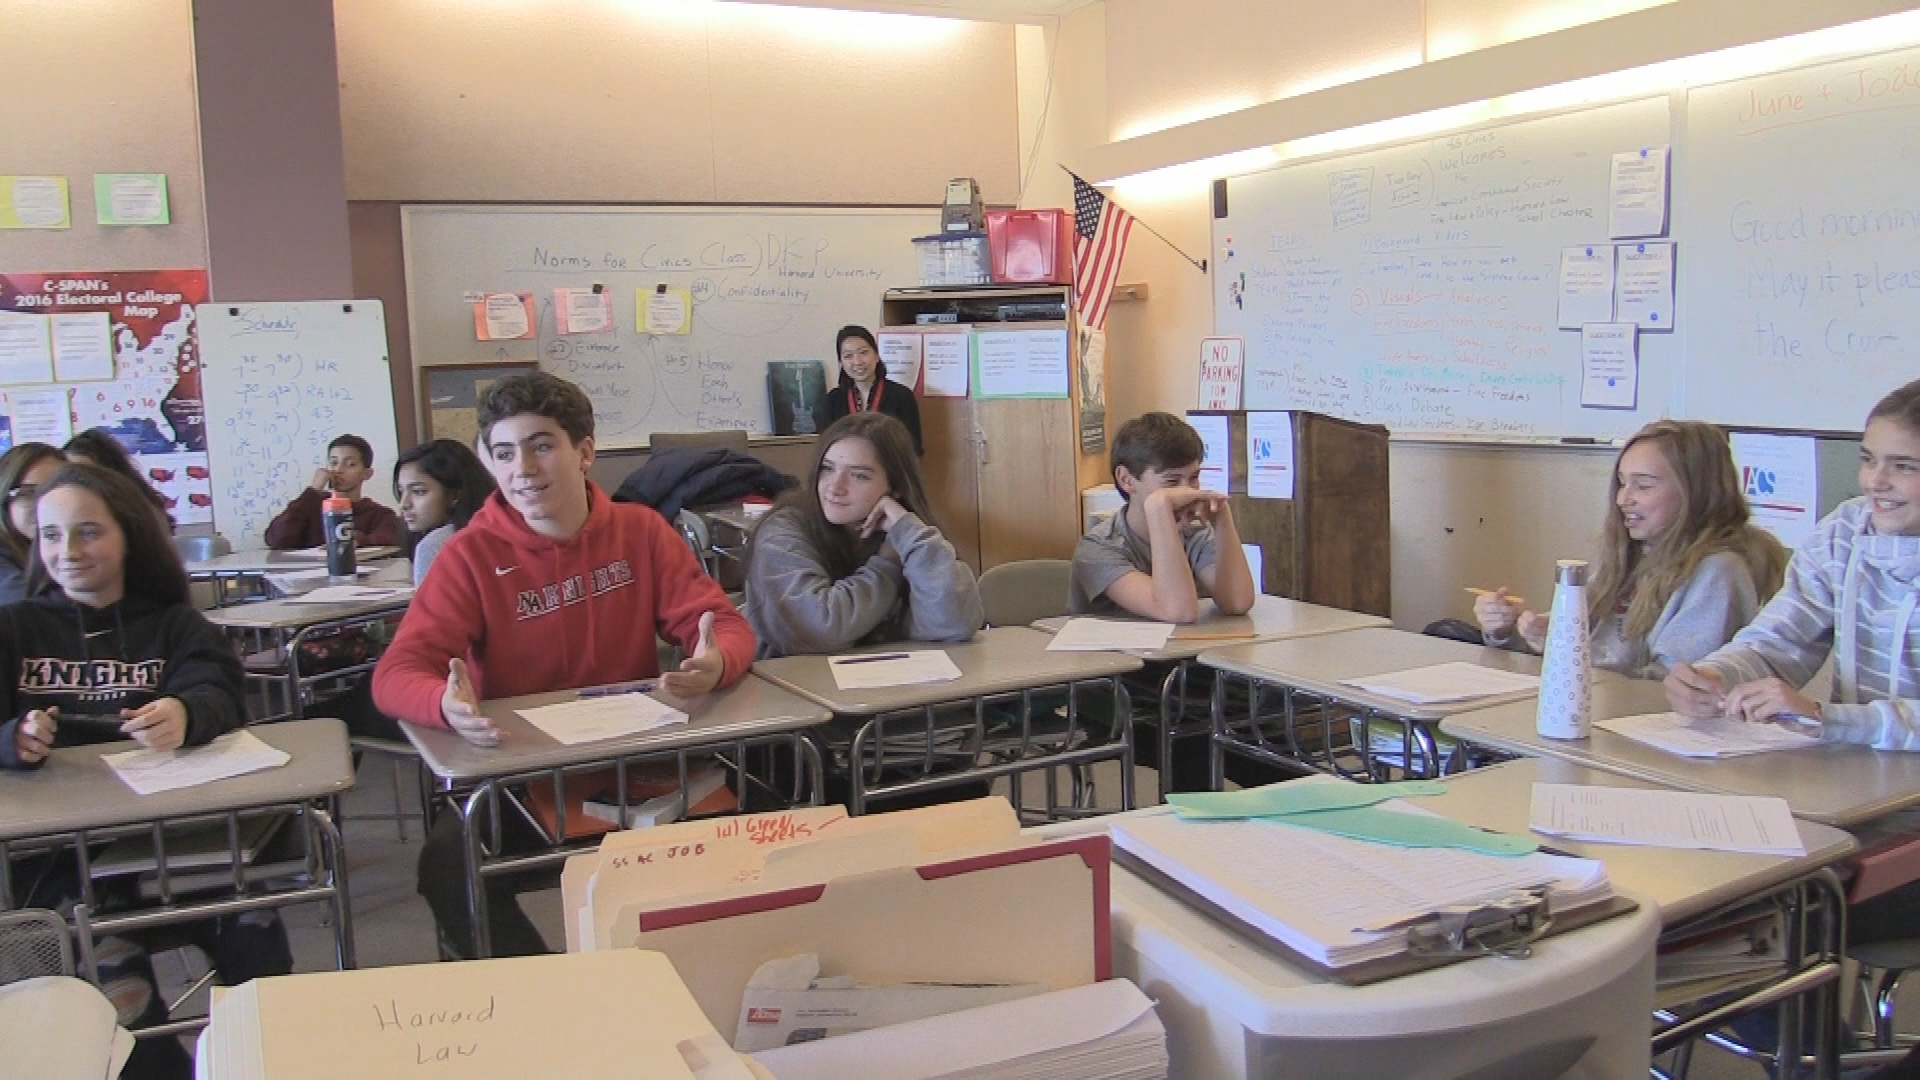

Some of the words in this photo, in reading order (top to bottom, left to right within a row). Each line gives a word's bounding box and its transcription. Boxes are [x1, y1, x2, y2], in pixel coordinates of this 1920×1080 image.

[1738, 88, 1804, 124] June
[1438, 145, 1508, 172] Welcomes
[1730, 202, 1807, 244] Good
[1820, 208, 1920, 238] mornin
[533, 246, 592, 269] Norms
[640, 243, 693, 269] Civics
[43, 279, 110, 293] C-SPAN's
[717, 277, 812, 303] Confidentiality
[1747, 258, 1807, 308] May
[1820, 260, 1841, 293] it
[15, 294, 53, 307] 2016
[56, 291, 123, 306] Electoral
[125, 289, 183, 305] College
[123, 305, 159, 319] Map
[1753, 312, 1803, 357] the
[1211, 344, 1229, 362] NO
[1201, 362, 1239, 382] PARKING
[96, 392, 105, 402] 6
[1209, 385, 1227, 397] TOW
[113, 403, 122, 413] 6
[126, 399, 136, 409] 9
[141, 397, 156, 408] 16
[1375, 397, 1402, 413] Class
[1411, 397, 1454, 416] Debate
[335, 520, 353, 541] G
[542, 559, 634, 608] KNIHTS
[667, 842, 705, 859] JOB
[372, 995, 495, 1031] Harvard
[416, 1041, 478, 1065] Law
